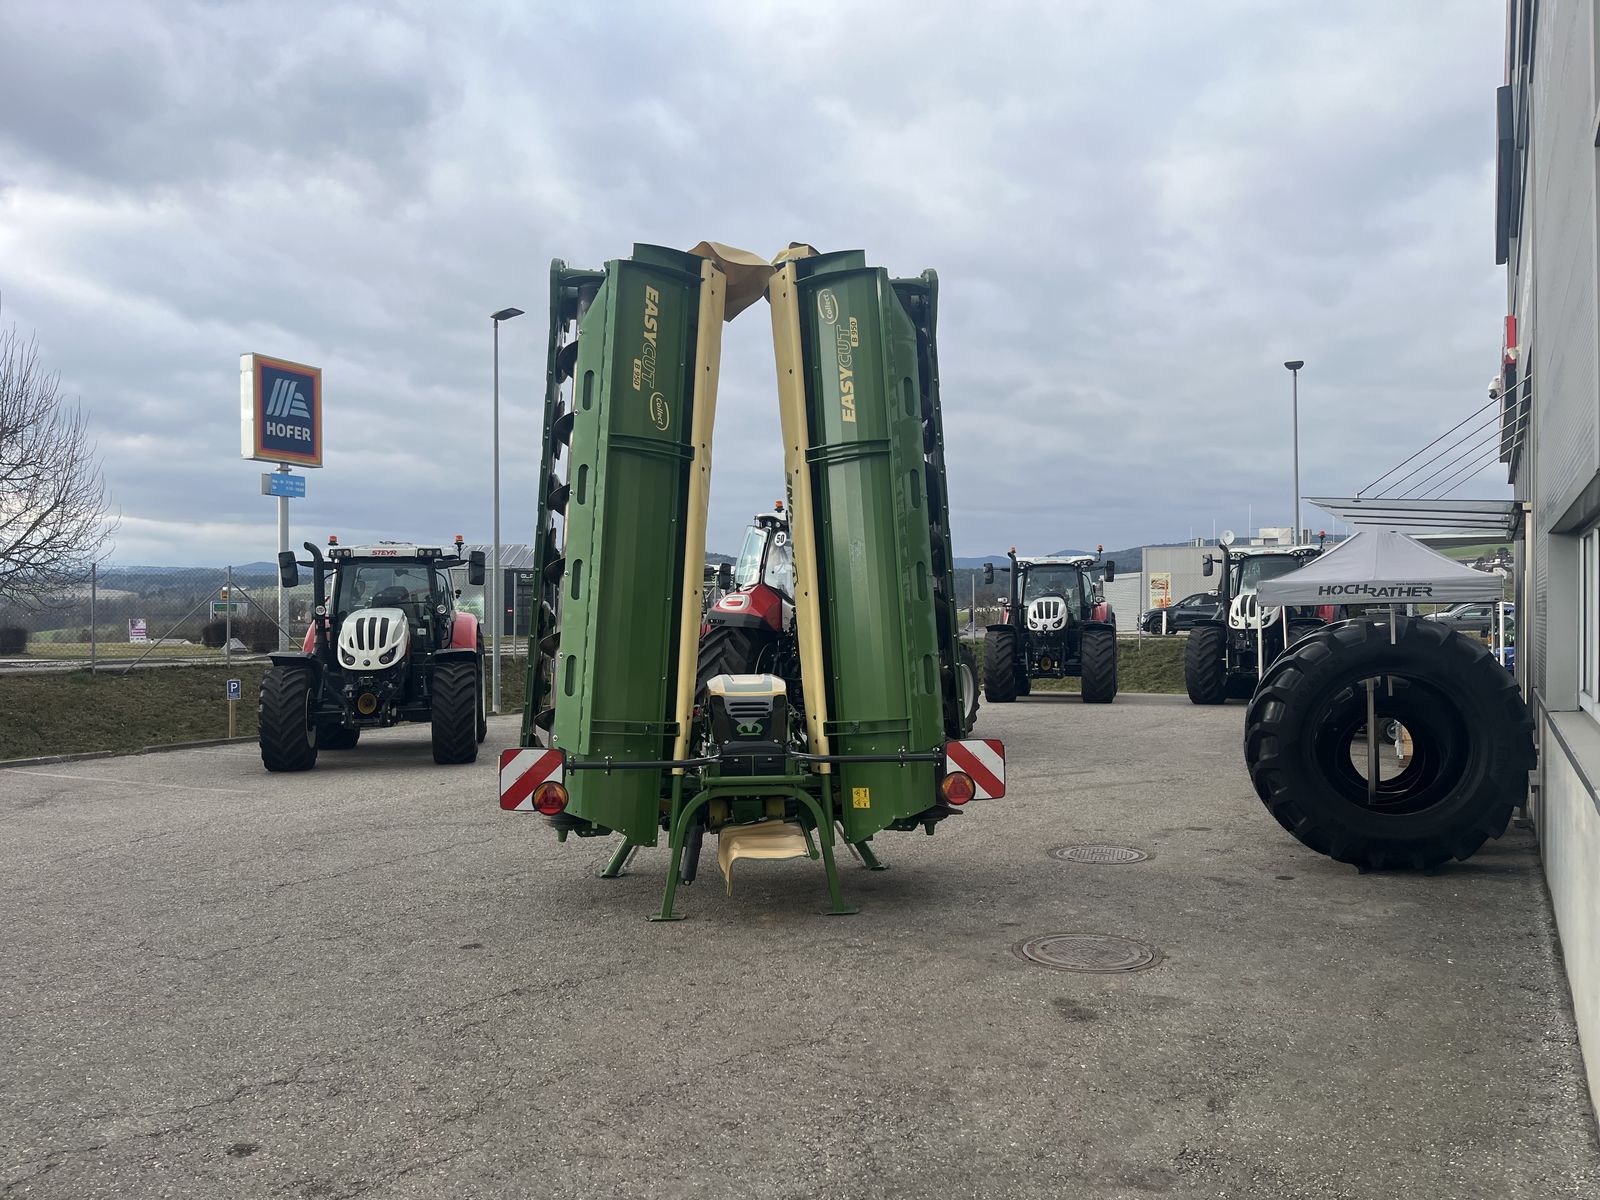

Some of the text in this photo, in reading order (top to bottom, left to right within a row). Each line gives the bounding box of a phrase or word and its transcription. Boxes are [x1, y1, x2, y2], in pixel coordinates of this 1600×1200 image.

[824, 294, 833, 319] Collect
[633, 371, 641, 386] 950
[656, 397, 664, 425] Collect
[266, 421, 311, 441] HOFER
[776, 534, 785, 544] 50
[1318, 584, 1433, 597] HOCHRATHER
[230, 682, 238, 693] P
